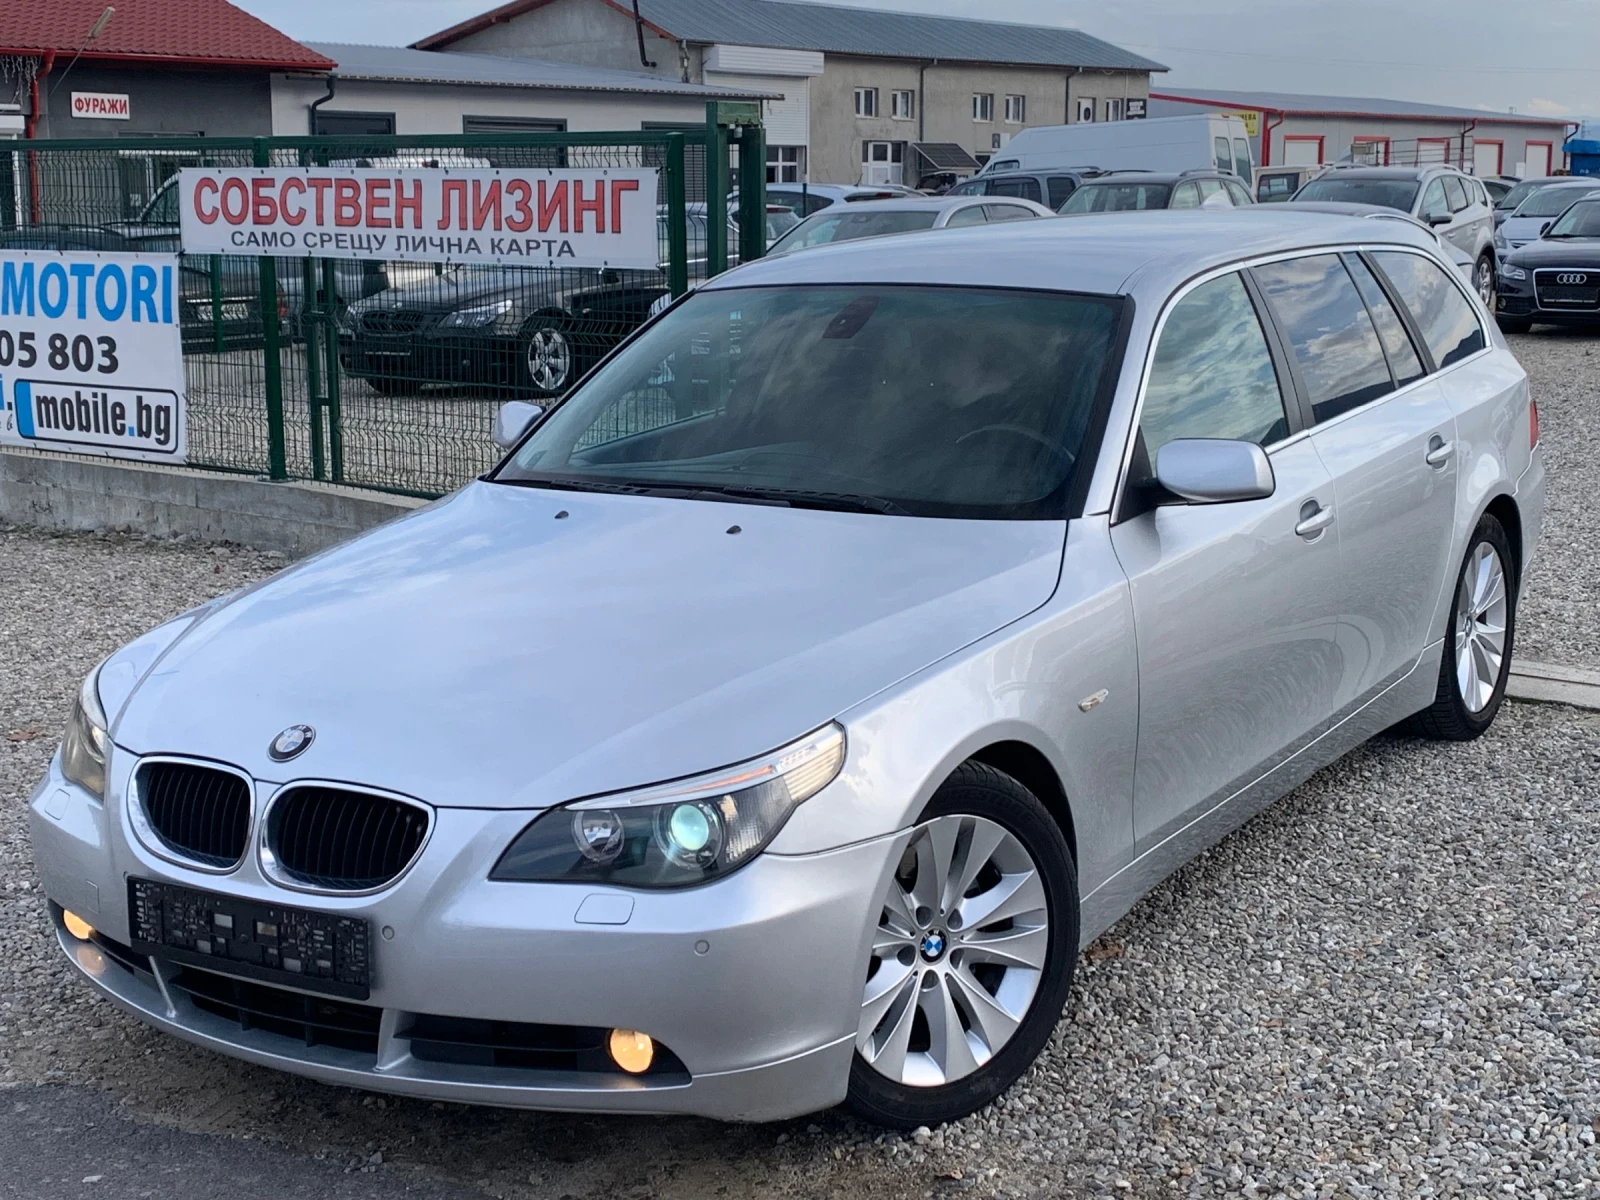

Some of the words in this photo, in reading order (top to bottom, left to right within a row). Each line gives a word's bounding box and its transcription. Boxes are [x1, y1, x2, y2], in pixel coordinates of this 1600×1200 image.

[75, 97, 127, 114] ФУРАЖИ
[194, 177, 422, 229] СОБСТВЕН
[437, 179, 639, 234] ЛИЗИНГ
[231, 230, 296, 247] САМО
[303, 231, 386, 252] СРЕЩУ
[395, 235, 482, 254] ЛИЧНА
[490, 238, 576, 257] КАРТА
[2, 262, 173, 324] MOTORI
[0, 330, 37, 368] 05
[48, 333, 119, 374] 803
[36, 390, 171, 446] mobile.bg
